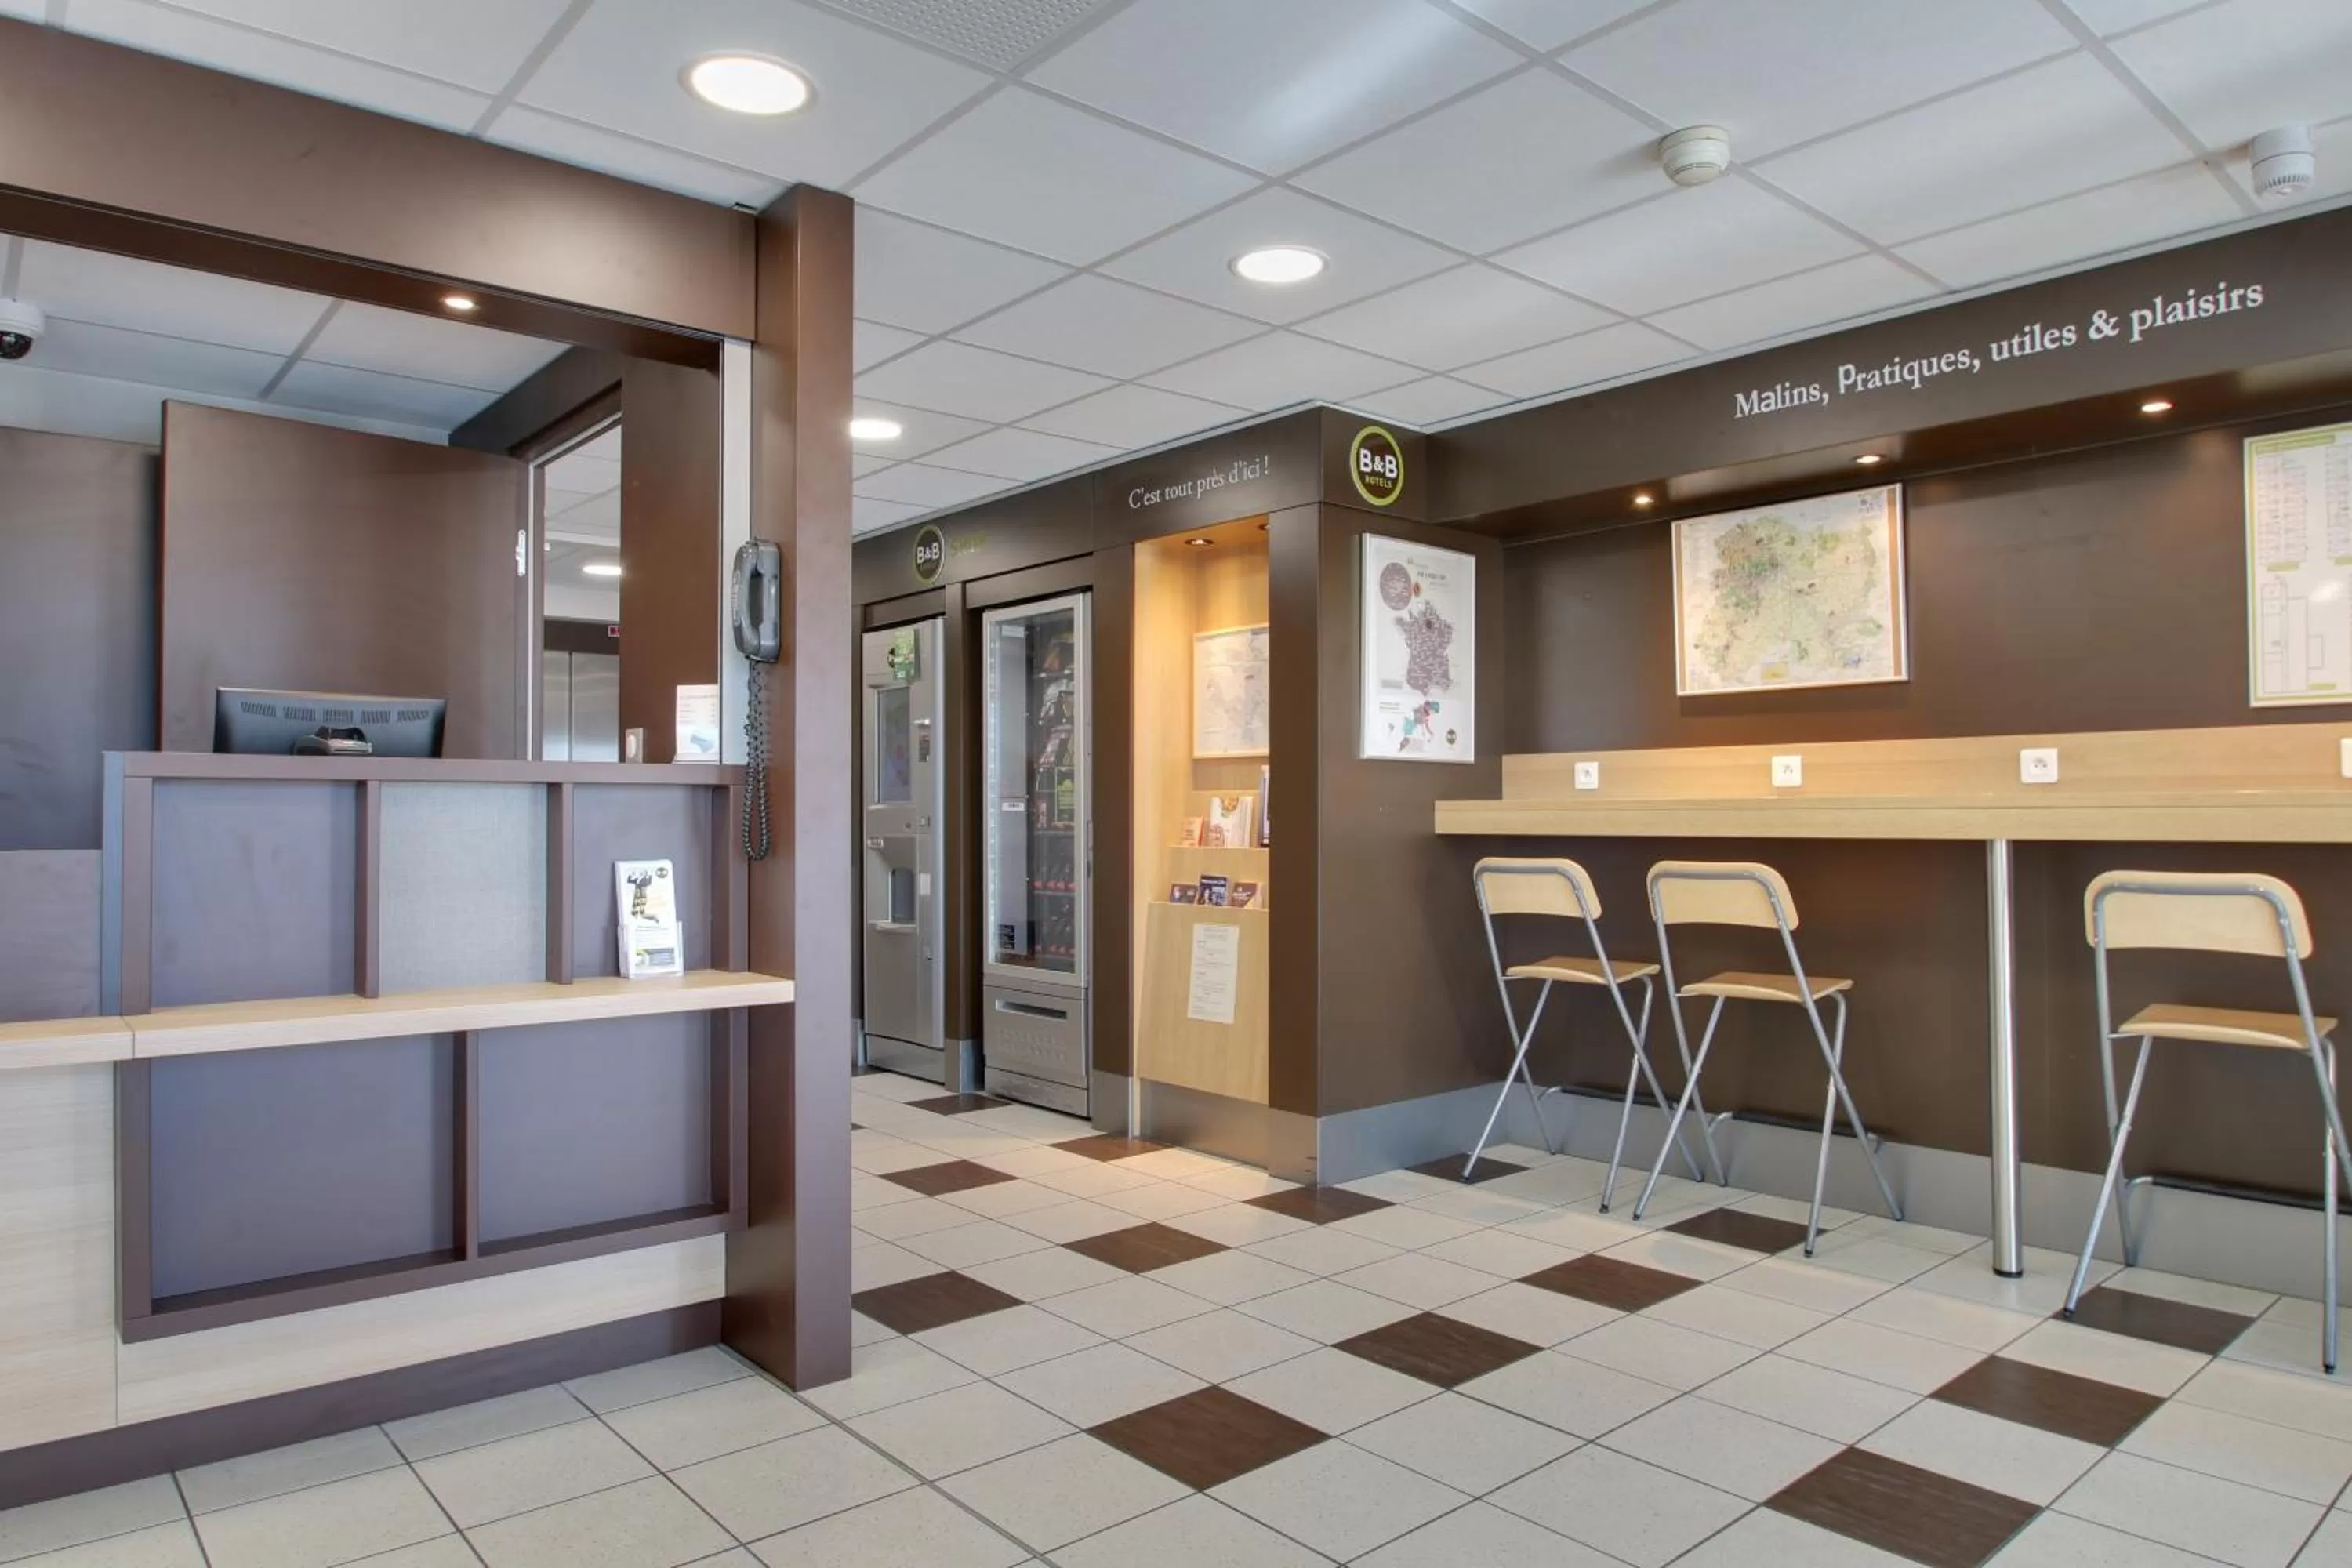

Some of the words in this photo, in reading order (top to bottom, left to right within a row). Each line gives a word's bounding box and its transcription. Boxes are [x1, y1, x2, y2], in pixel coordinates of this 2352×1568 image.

[1733, 381, 1829, 419] Malins,
[1838, 348, 1980, 394] Pratiques,
[1989, 322, 2077, 361] utiles
[2088, 310, 2120, 340] &
[2128, 281, 2265, 343] plaisirs
[1359, 448, 1398, 479] B&B
[1128, 486, 1161, 509] C'est
[1164, 481, 1192, 501] tout
[1196, 468, 1226, 499] près
[916, 542, 940, 564] B&B
